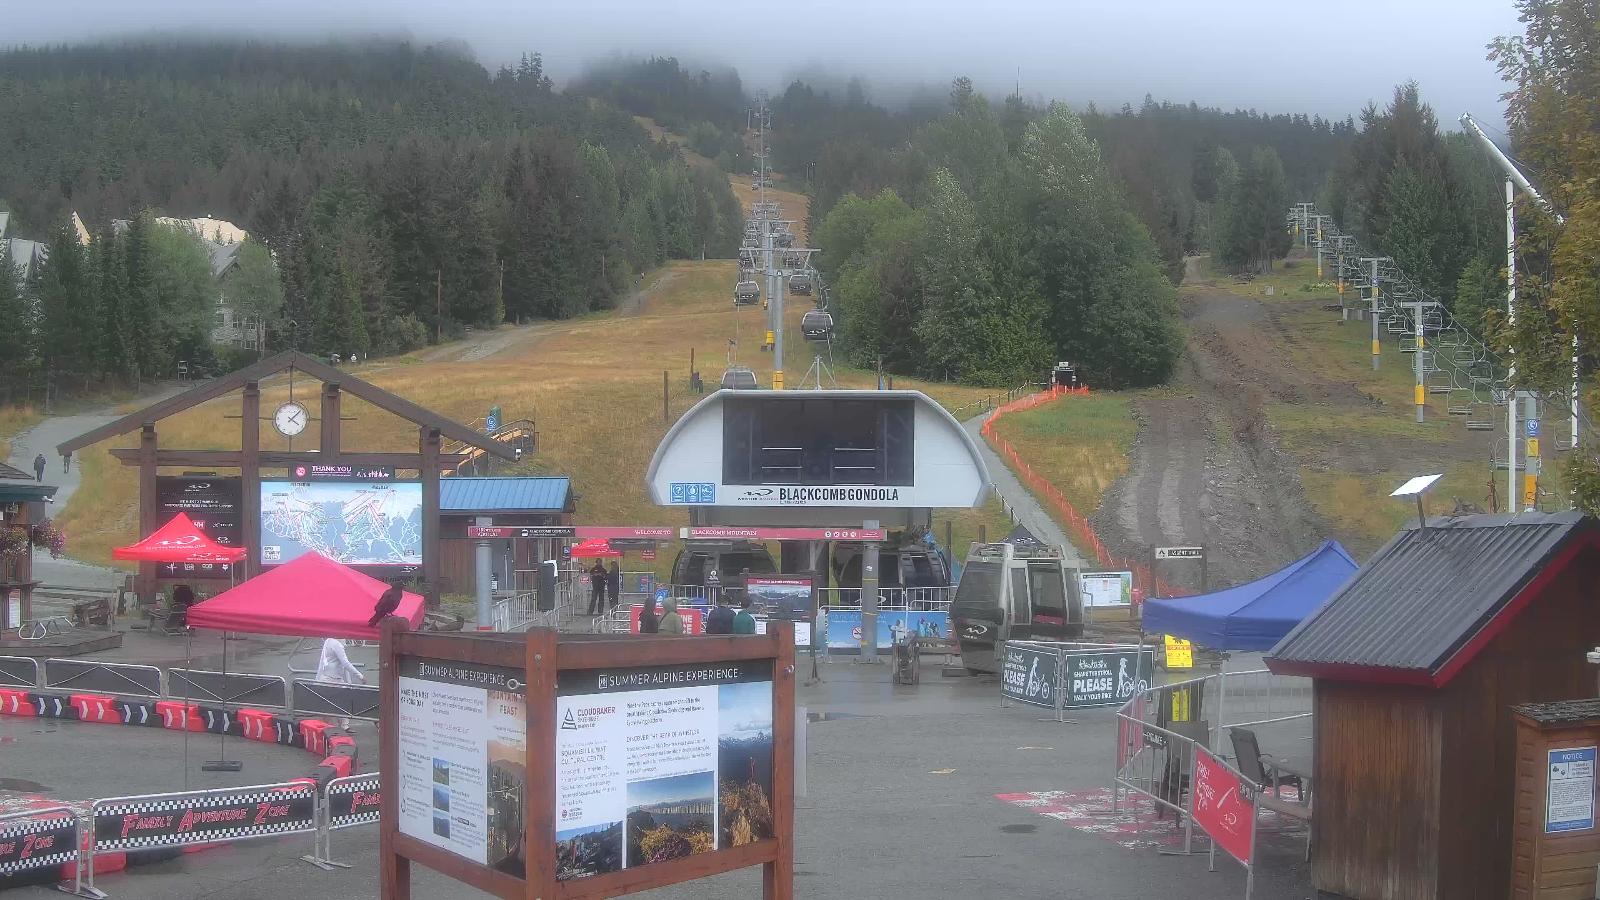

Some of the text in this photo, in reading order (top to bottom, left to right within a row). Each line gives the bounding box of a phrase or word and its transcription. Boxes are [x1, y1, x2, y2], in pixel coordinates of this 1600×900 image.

[779, 487, 899, 501] BLACKCOMB GONDOLA
[424, 664, 505, 686] SUMMER ALPINE EXPERIENCE
[609, 668, 739, 687] SUMMER ALPINE EXPERIENCE
[1003, 669, 1026, 687] PLEASE
[1073, 677, 1113, 693] PLEASE
[500, 704, 518, 716] FEAST
[577, 706, 616, 717] CLOUDRAKER
[1562, 752, 1583, 760] NOTICE
[121, 802, 291, 838] FAMILY ADVENTURE ZONE
[20, 833, 55, 859] ZONE
